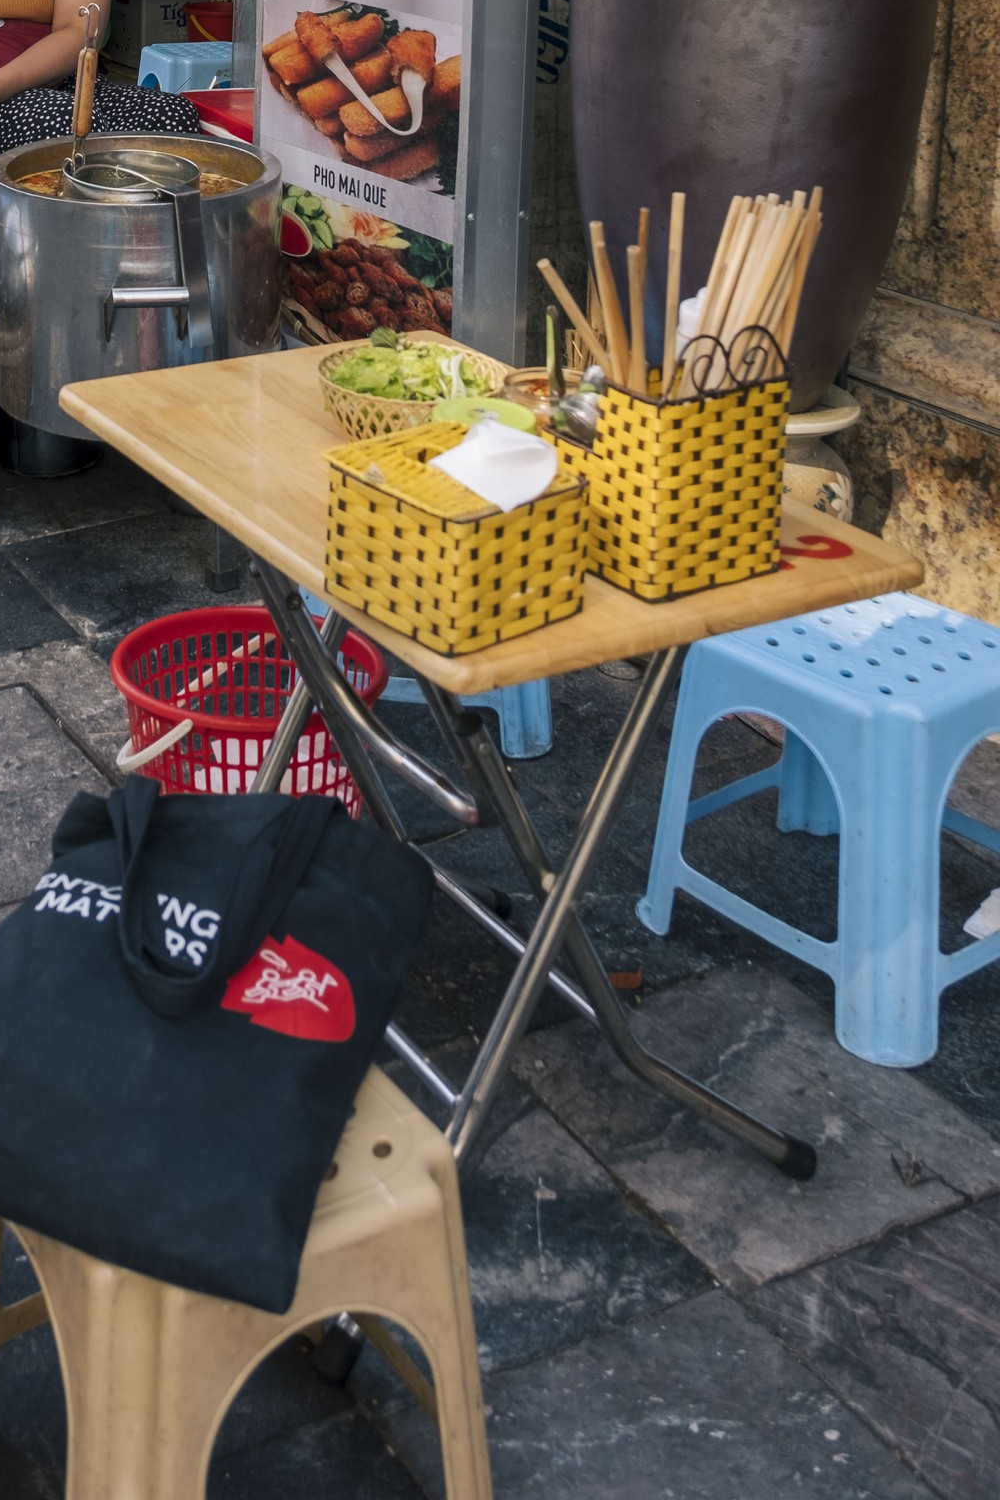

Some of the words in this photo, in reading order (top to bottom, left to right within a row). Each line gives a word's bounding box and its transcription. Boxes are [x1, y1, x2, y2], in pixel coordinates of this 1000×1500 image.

[314, 164, 336, 188] PHO
[338, 172, 360, 198] MAI
[363, 182, 386, 209] QUE
[34, 889, 208, 967] MATRS
